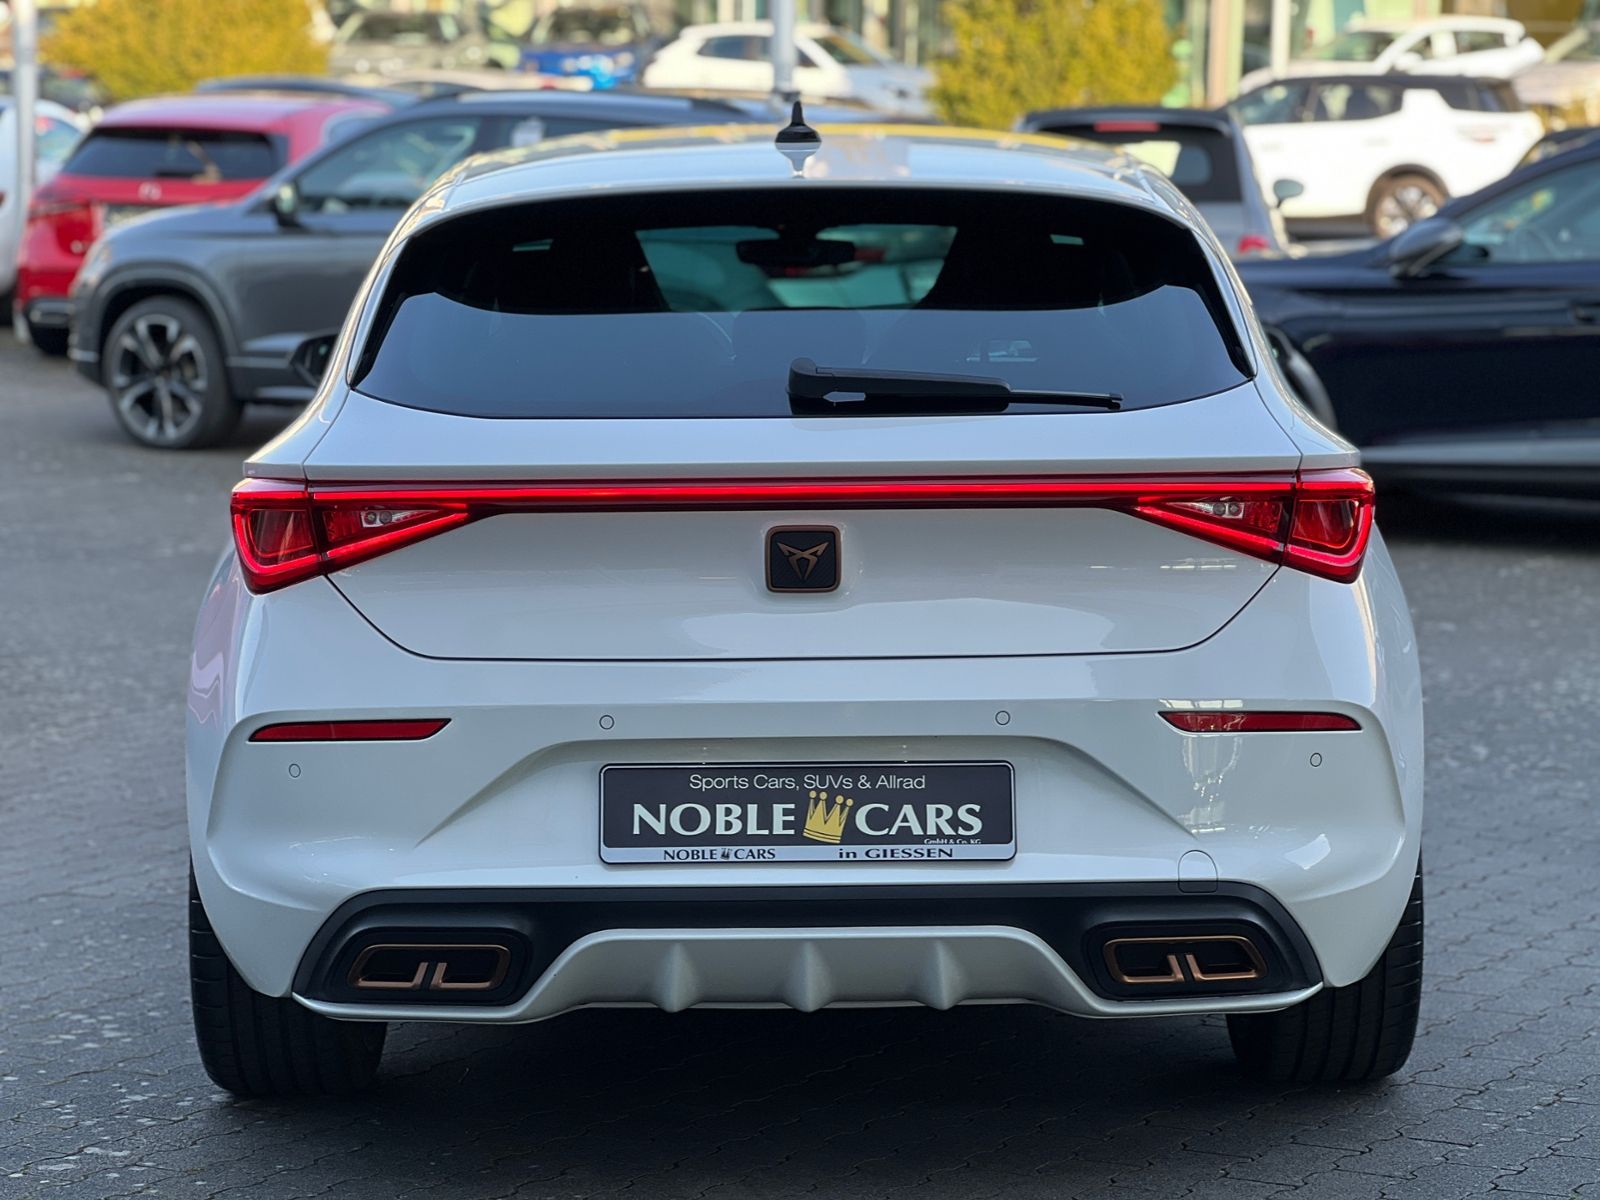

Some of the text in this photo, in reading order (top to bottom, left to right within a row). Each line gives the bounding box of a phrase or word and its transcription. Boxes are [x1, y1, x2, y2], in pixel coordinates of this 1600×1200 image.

[689, 774, 926, 791] Sports Cars, SUVs & Allrad
[632, 803, 983, 836] NOBLE CARS
[663, 848, 776, 860] NOBLE CARS
[838, 848, 953, 859] in GIESSEN
